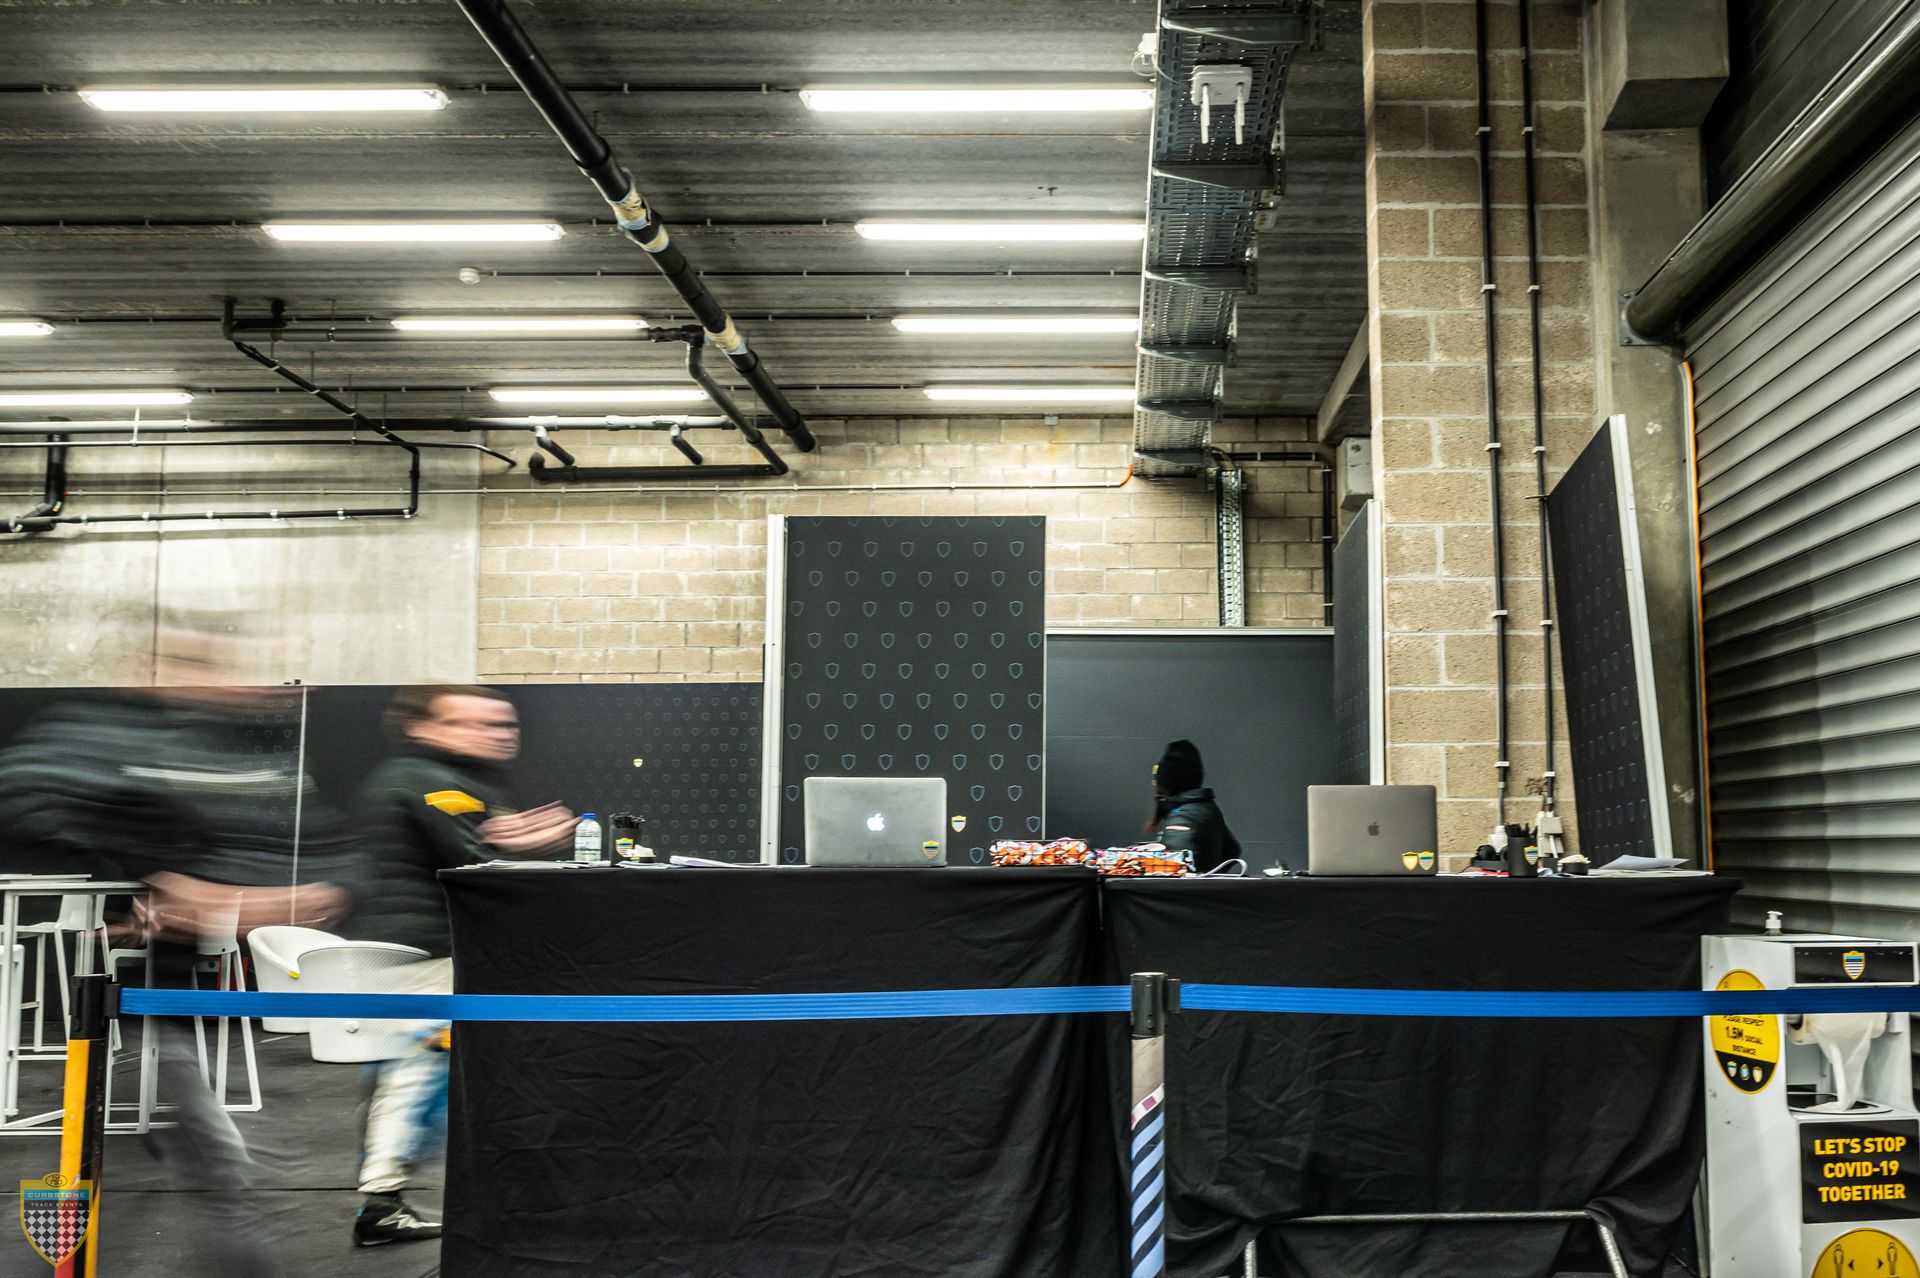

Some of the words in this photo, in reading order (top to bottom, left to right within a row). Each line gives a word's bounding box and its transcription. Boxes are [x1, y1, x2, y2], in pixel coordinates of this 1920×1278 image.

[1814, 1138, 1861, 1155] LET'S
[1863, 1136, 1907, 1153] STOP
[1823, 1160, 1899, 1178] COVID-19
[1818, 1184, 1906, 1202] TOGETHER
